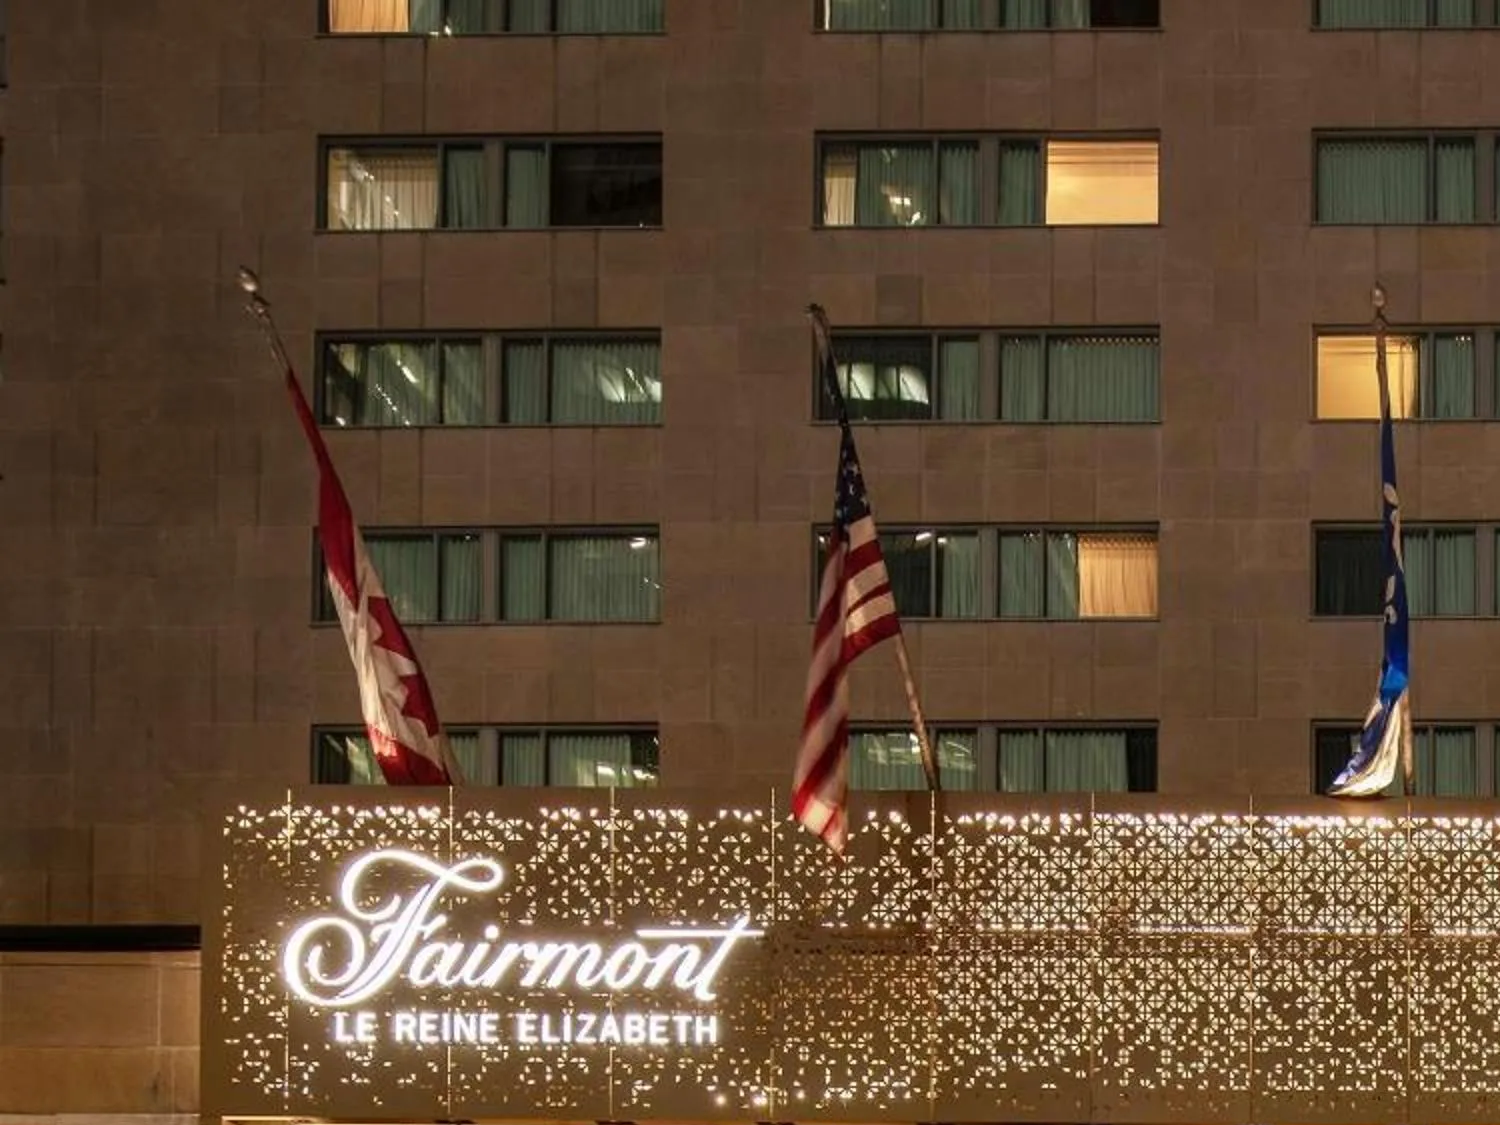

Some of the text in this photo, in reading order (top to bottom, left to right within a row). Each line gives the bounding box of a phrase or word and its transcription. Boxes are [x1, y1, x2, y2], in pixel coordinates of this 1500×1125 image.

[284, 850, 765, 1006] Fairmont
[334, 1011, 718, 1043] LE REINE ELIZABETH
